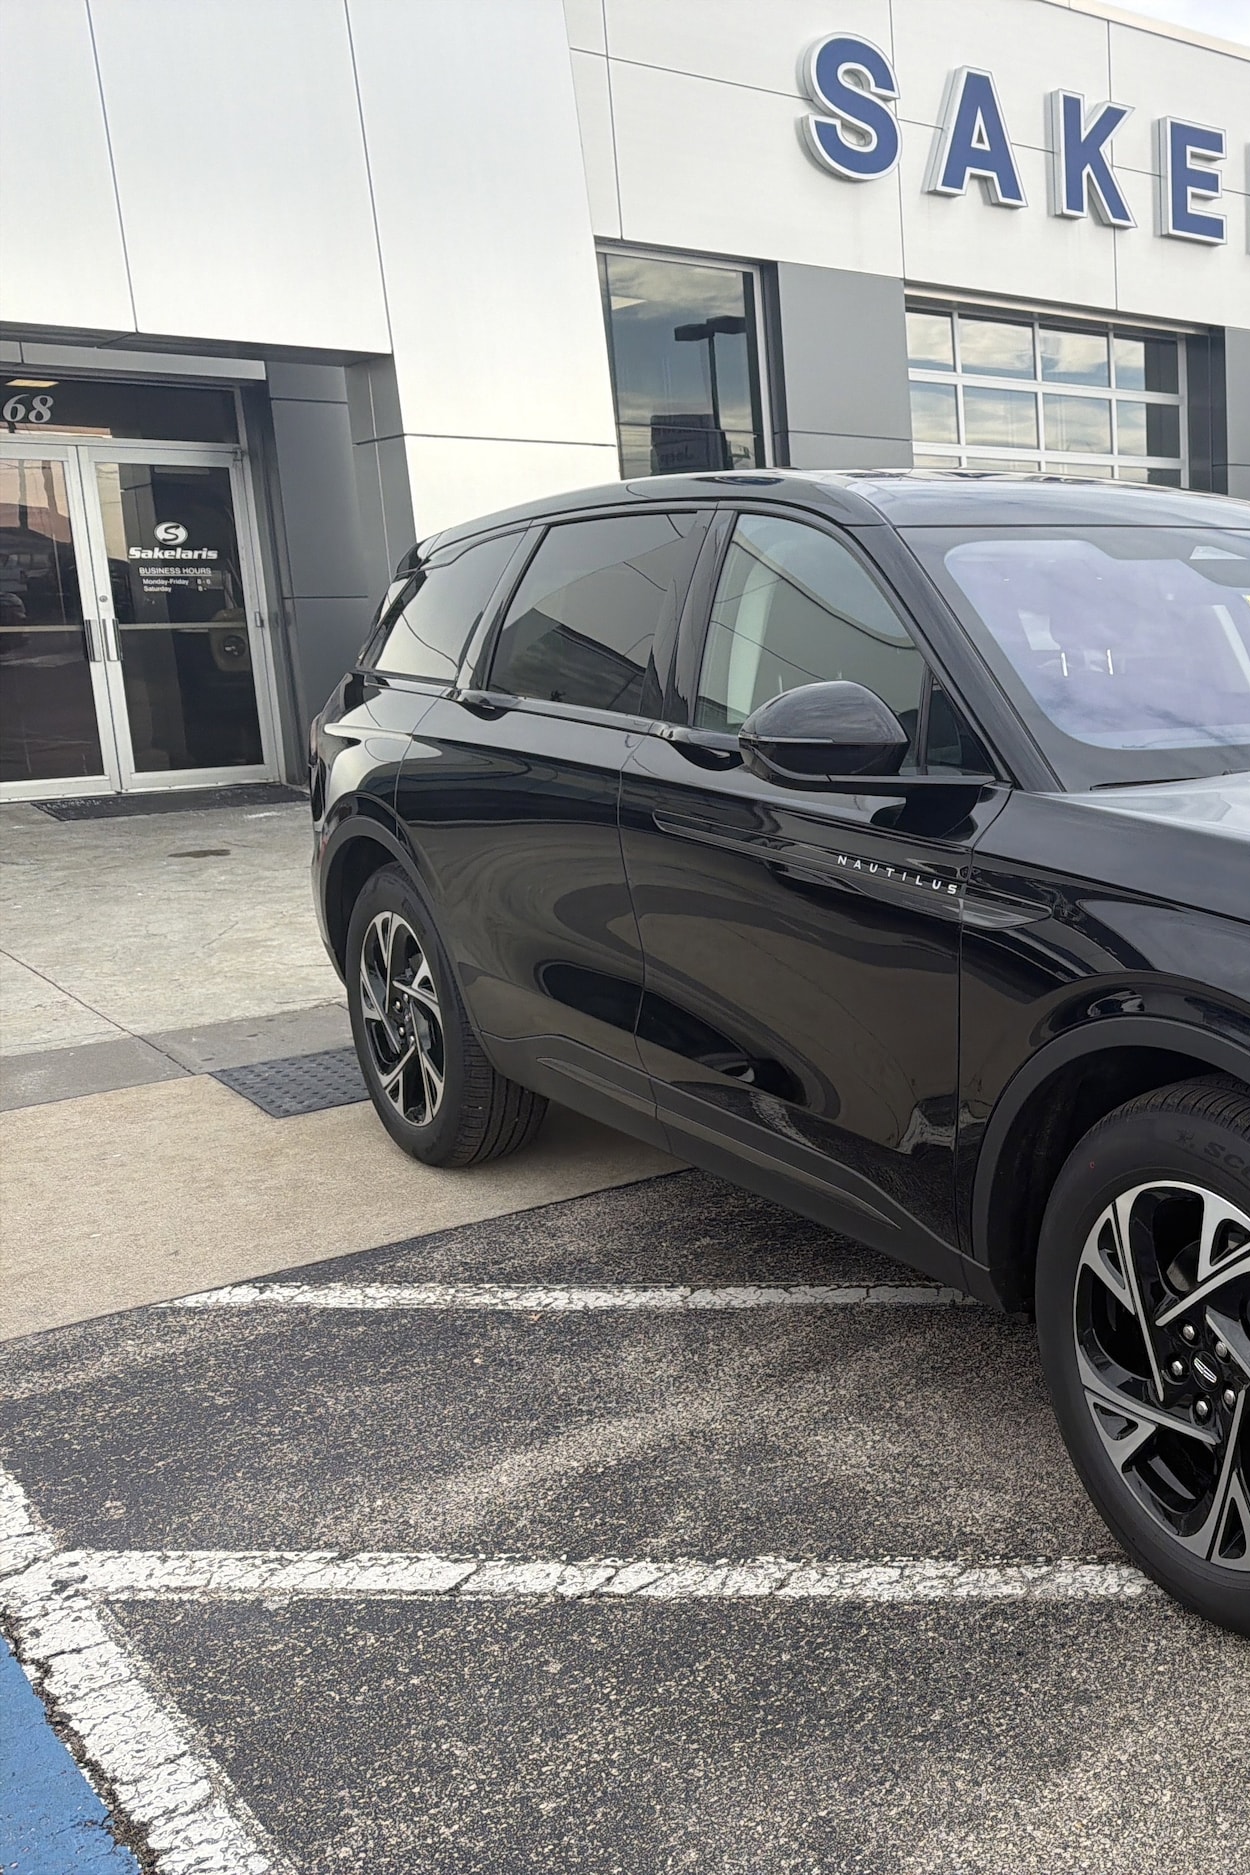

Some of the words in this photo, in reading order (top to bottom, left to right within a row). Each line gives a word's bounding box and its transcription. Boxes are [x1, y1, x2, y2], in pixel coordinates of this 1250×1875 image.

[2, 393, 54, 423] 68
[128, 547, 218, 559] Sakelaris
[139, 566, 181, 575] BUSINESS
[182, 567, 212, 575] HOURS
[142, 578, 189, 586] Monday-Friday
[143, 585, 172, 593] Saturday
[837, 854, 958, 895] NAUTILUS
